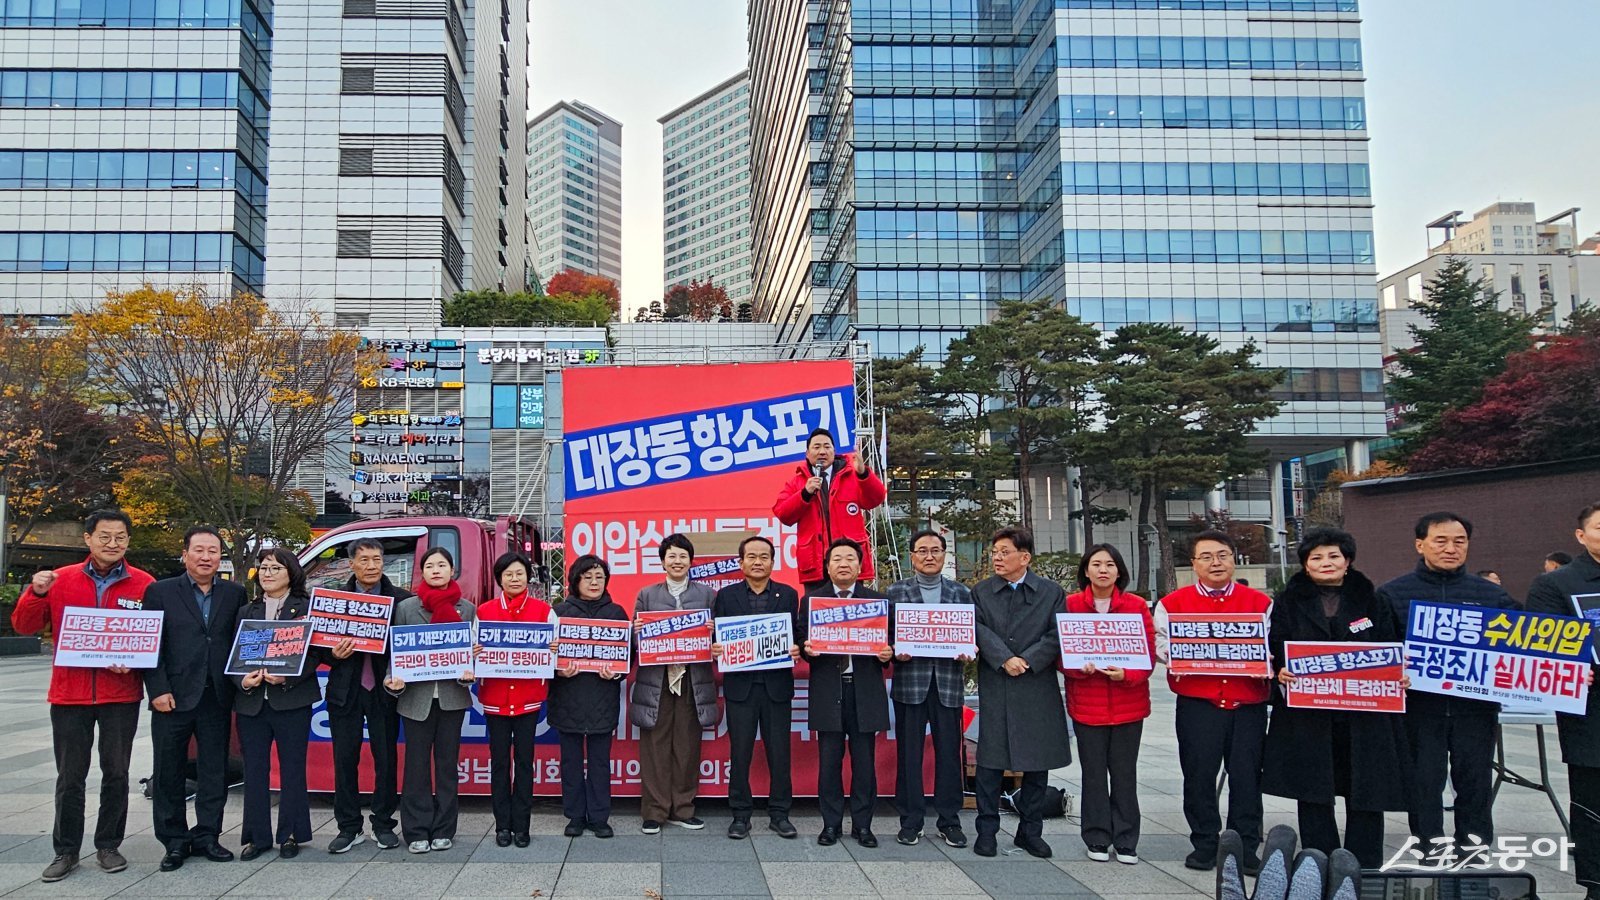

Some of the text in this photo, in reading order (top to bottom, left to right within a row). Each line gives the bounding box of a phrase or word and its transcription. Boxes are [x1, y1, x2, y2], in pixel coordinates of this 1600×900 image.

[521, 388, 543, 400] 산부
[521, 402, 543, 414] 인과
[519, 416, 544, 425] 여의사
[569, 392, 850, 491] 대장동 항소포기
[364, 453, 425, 464] NANAENG
[690, 563, 717, 579] 대장동
[313, 596, 390, 619] 대장동 항소포기
[811, 600, 886, 624] 대장동 항소포기
[65, 615, 160, 633] 대장동 수사외압
[641, 610, 709, 638] 대장동 항소포기
[898, 610, 972, 624] 대장동 수사외압
[310, 616, 386, 639] 외압실체 특검하라
[479, 628, 553, 644] 5개 재판재개
[560, 624, 629, 641] 대장동 항소포기
[721, 619, 787, 642] 대장동 항소 포기
[811, 626, 886, 643] 외압실체 특검하라
[897, 628, 972, 642] 국정조사 실시하라
[1061, 621, 1141, 635] 대장동 수사외압
[1171, 622, 1264, 638] 대장동 항소포기
[1412, 605, 1483, 645] 대장동
[1484, 612, 1591, 656] 수사외압
[60, 634, 156, 651] 국정조사 실시하라
[394, 628, 470, 647] 5개 재판재개
[640, 637, 711, 654] 외압실체 특검하라
[1063, 638, 1144, 653] 국정조사 실시하라
[558, 643, 628, 660] 외압실체 특검하라
[722, 633, 789, 666] 사법정의 사망선고
[1171, 643, 1265, 660] 외압실체 특검하라
[395, 651, 471, 669] 국민의 명령이다
[479, 651, 552, 666] 국민의 명령이다
[1290, 647, 1402, 674] 대장동 항소포기
[1406, 642, 1584, 699] 국정조사 실시하라
[1290, 677, 1401, 697] 외압실체 특검하라
[1456, 684, 1489, 695] 국민의힘
